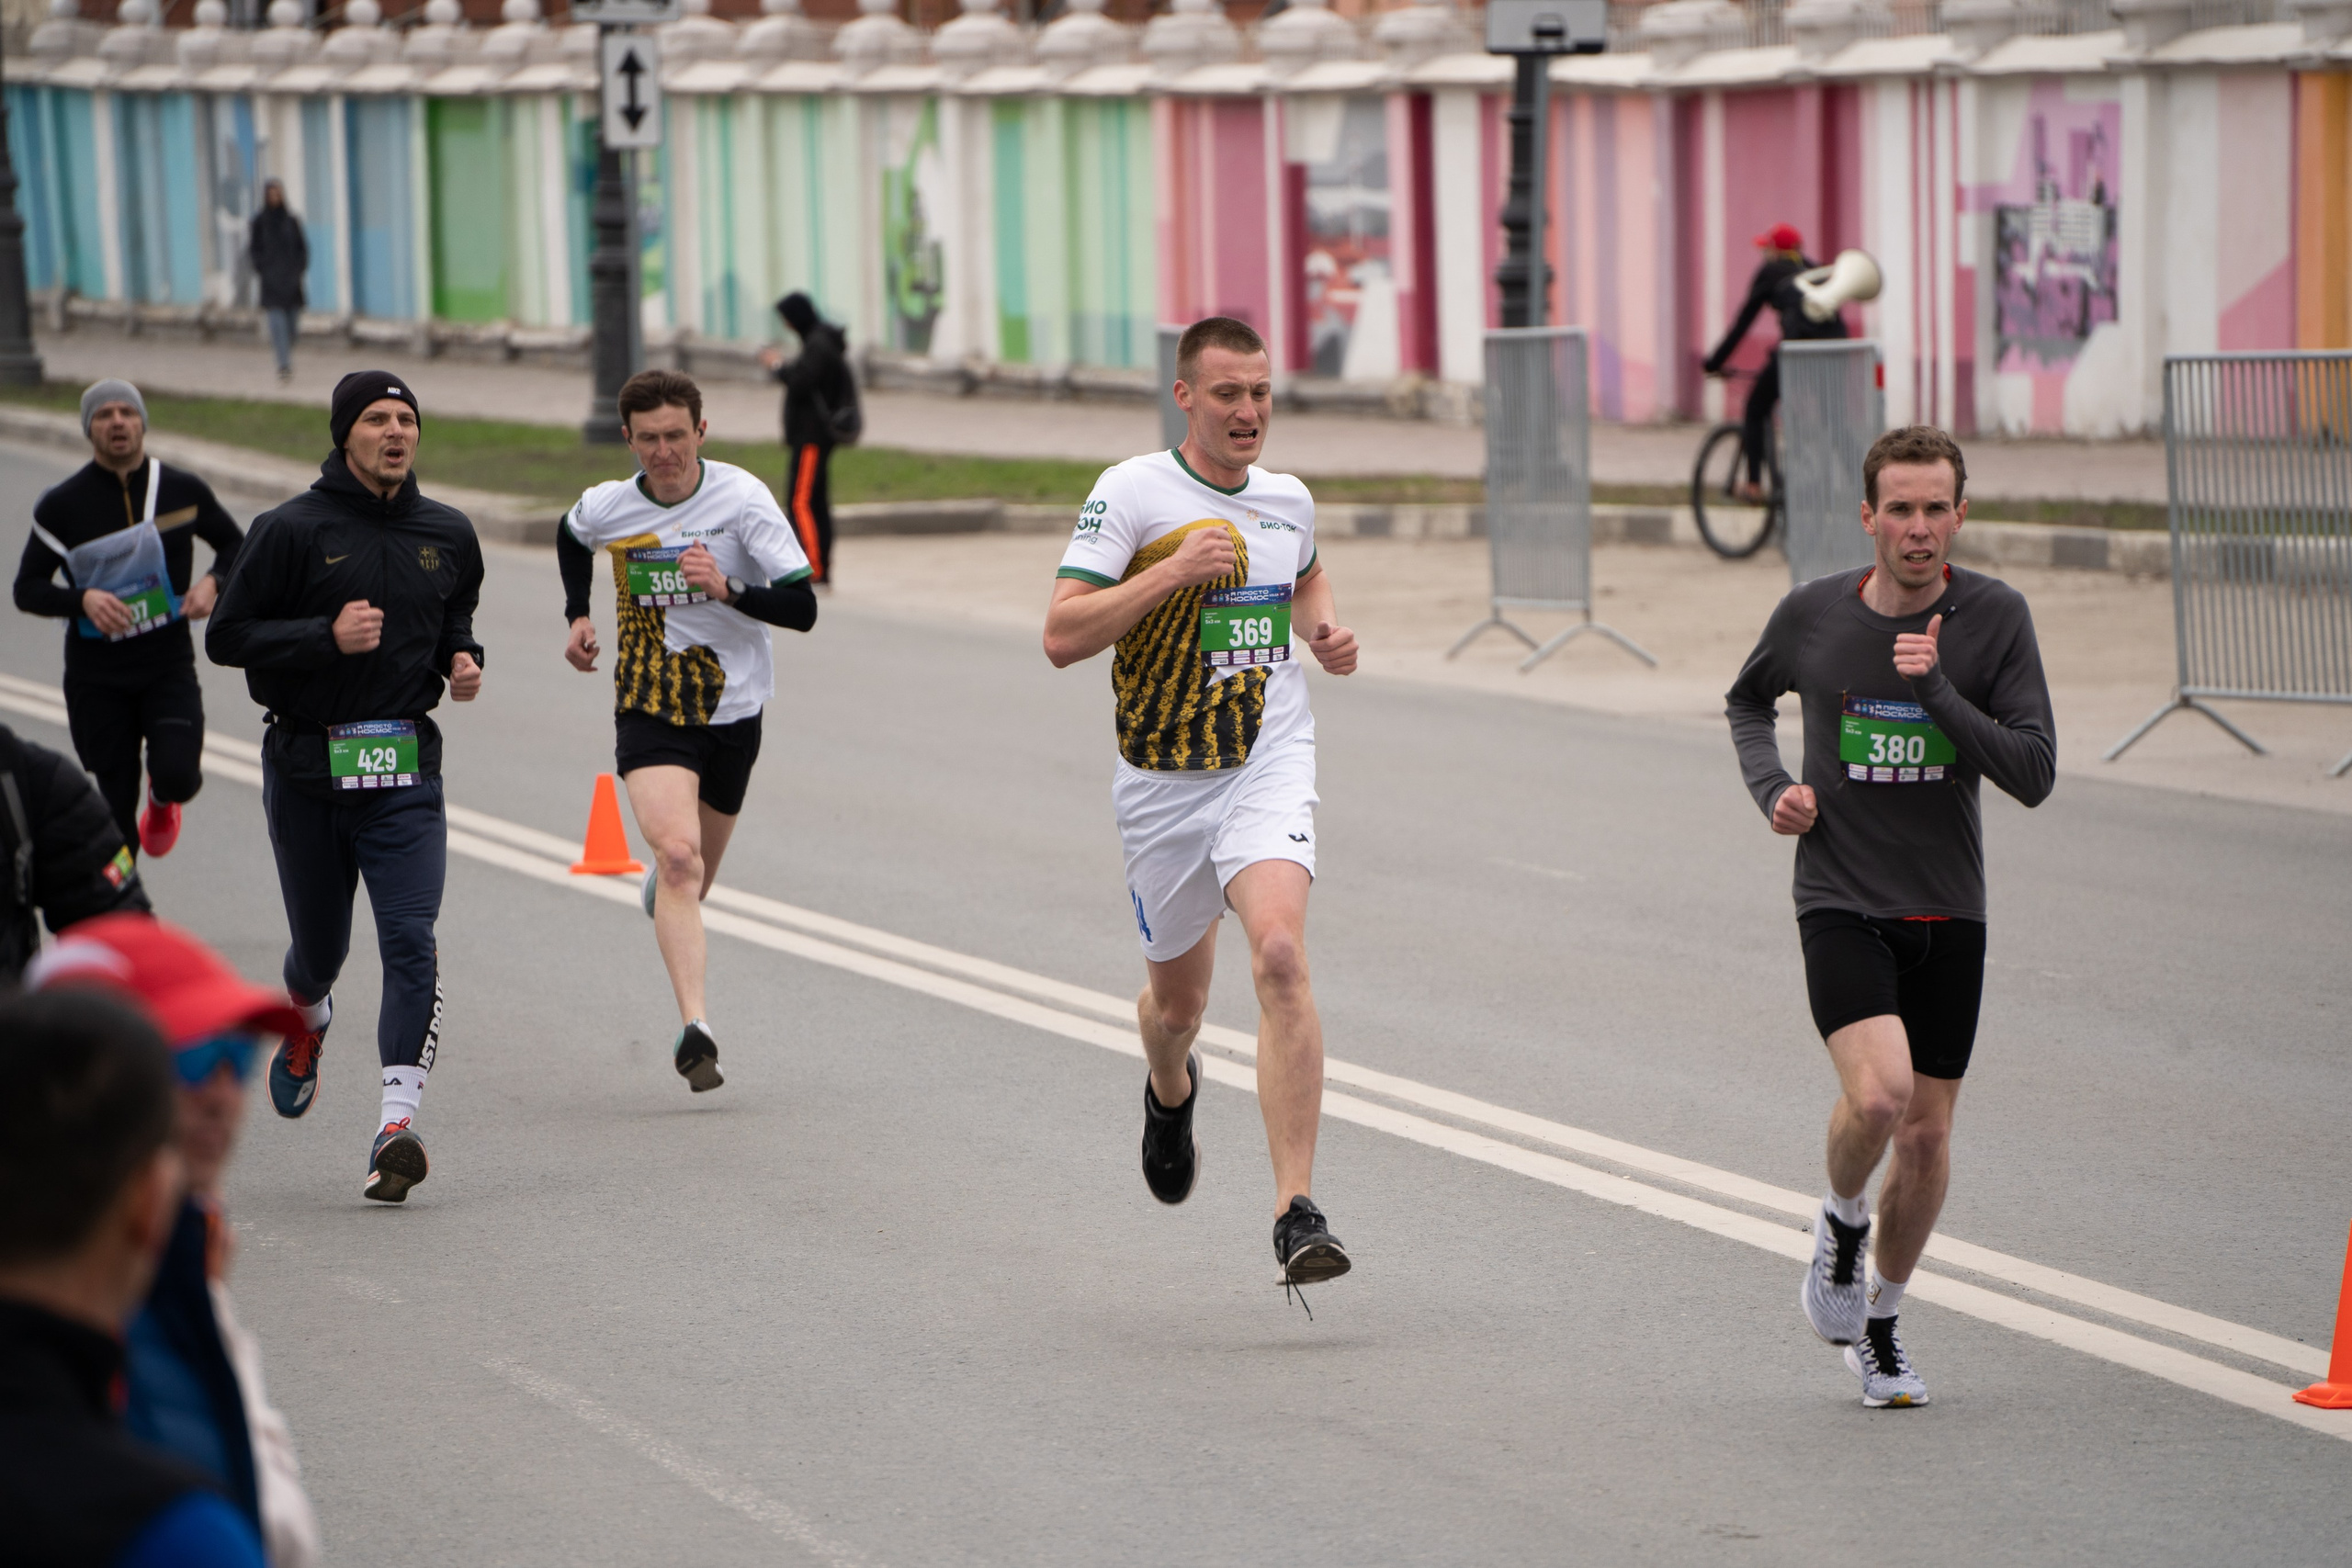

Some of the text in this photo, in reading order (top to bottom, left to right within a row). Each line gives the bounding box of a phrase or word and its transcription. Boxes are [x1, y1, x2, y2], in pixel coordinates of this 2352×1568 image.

[1077, 516, 1102, 533] ОН
[649, 570, 688, 592] 366
[1228, 616, 1272, 647] 369
[1883, 705, 1924, 713] ПРОСТО
[357, 747, 397, 773] 429
[1868, 733, 1926, 764] 380
[418, 1033, 436, 1072] UST
[429, 1000, 443, 1035] DO
[383, 1077, 402, 1087] LA
